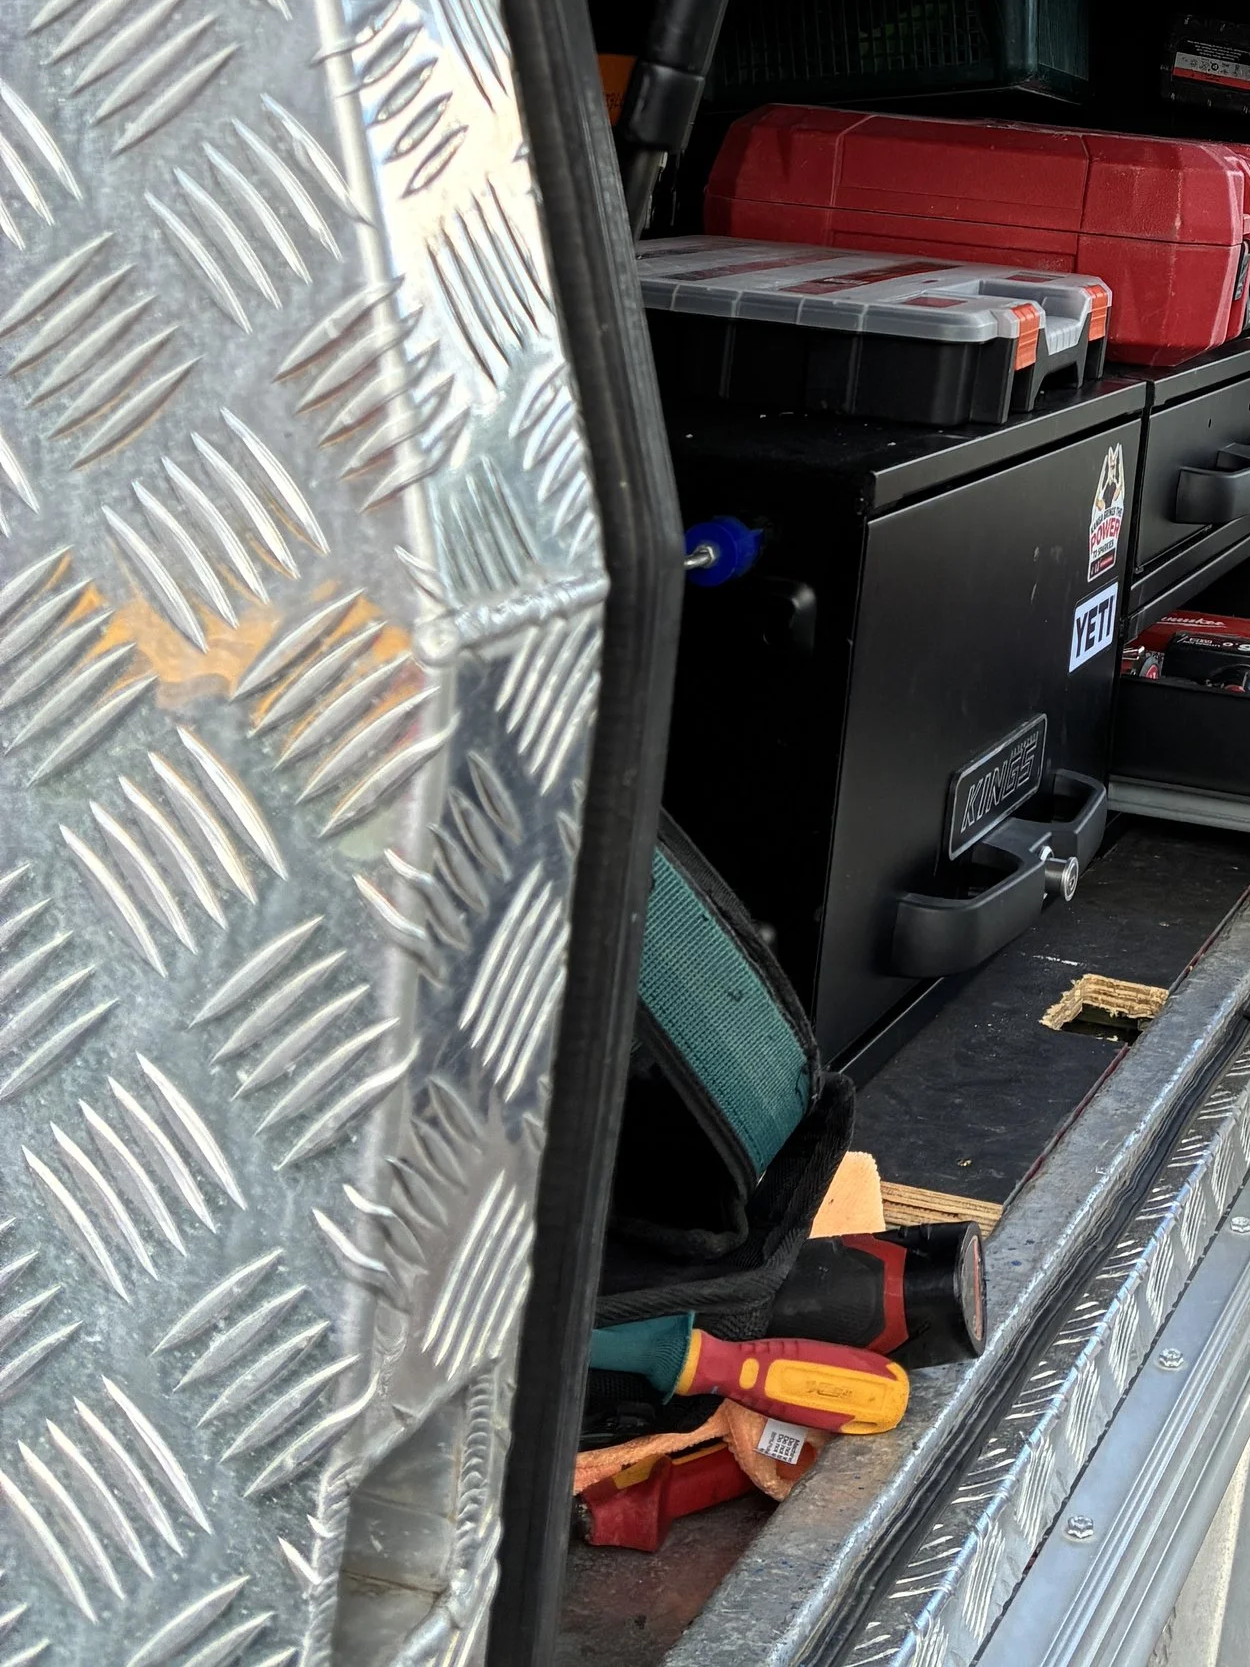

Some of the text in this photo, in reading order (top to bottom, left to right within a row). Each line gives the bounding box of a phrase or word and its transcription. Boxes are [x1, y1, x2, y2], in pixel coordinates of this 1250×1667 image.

[1090, 517, 1120, 554] POWER
[1076, 595, 1114, 659] YETI
[960, 730, 1040, 834] KINGS
